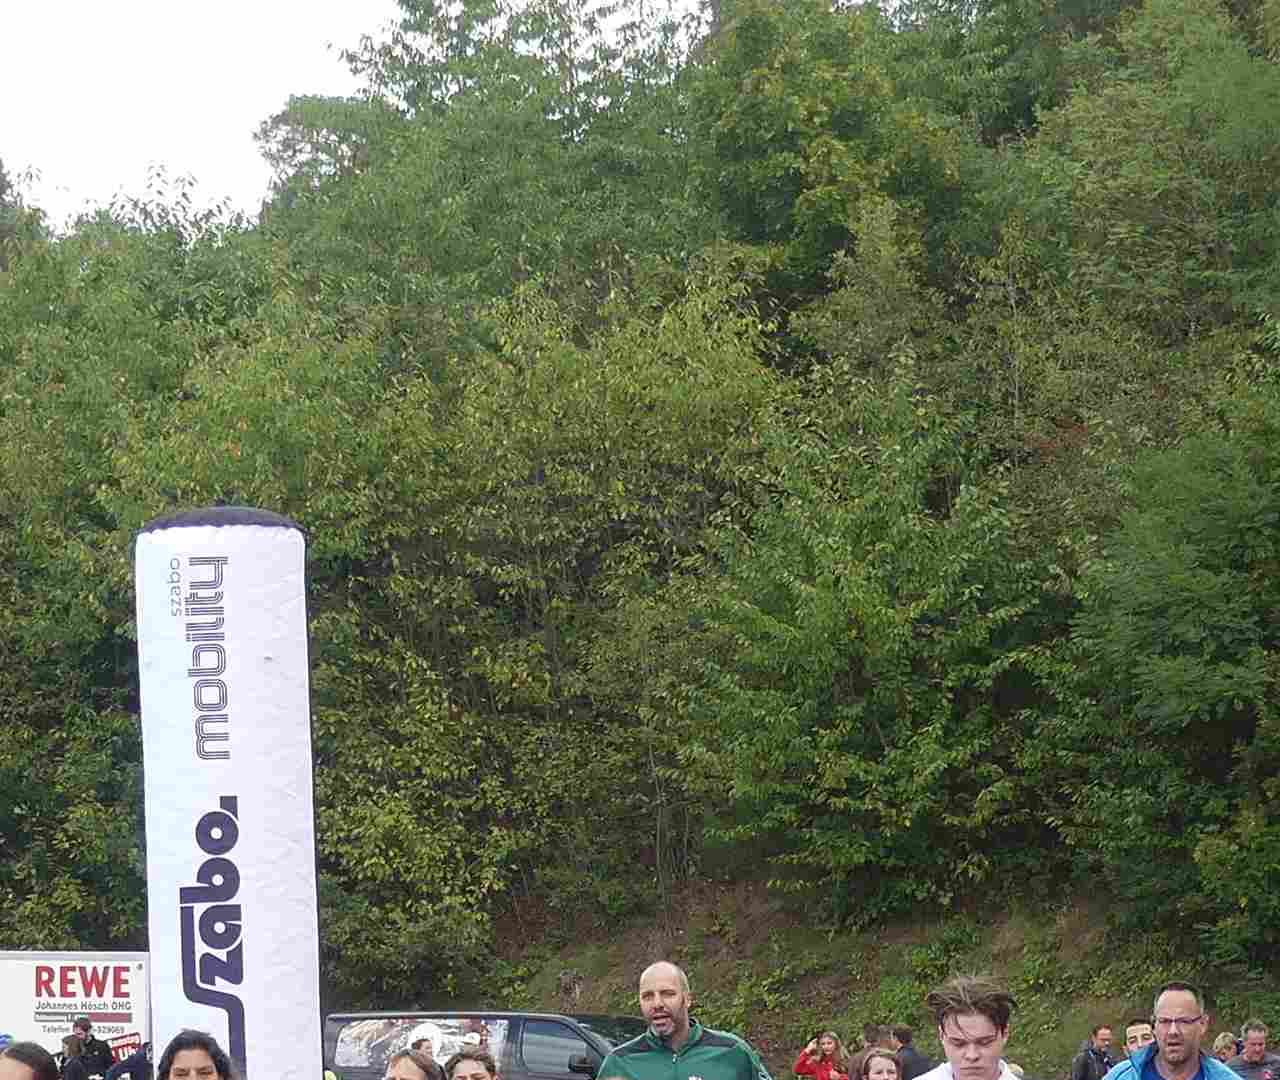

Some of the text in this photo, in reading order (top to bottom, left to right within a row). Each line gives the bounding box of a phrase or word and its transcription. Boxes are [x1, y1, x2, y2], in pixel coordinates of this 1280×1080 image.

[169, 557, 184, 617] szabo
[184, 556, 232, 761] mobility
[35, 965, 130, 998] REWE
[35, 1001, 79, 1011] Johannes
[111, 1001, 132, 1010] OHG
